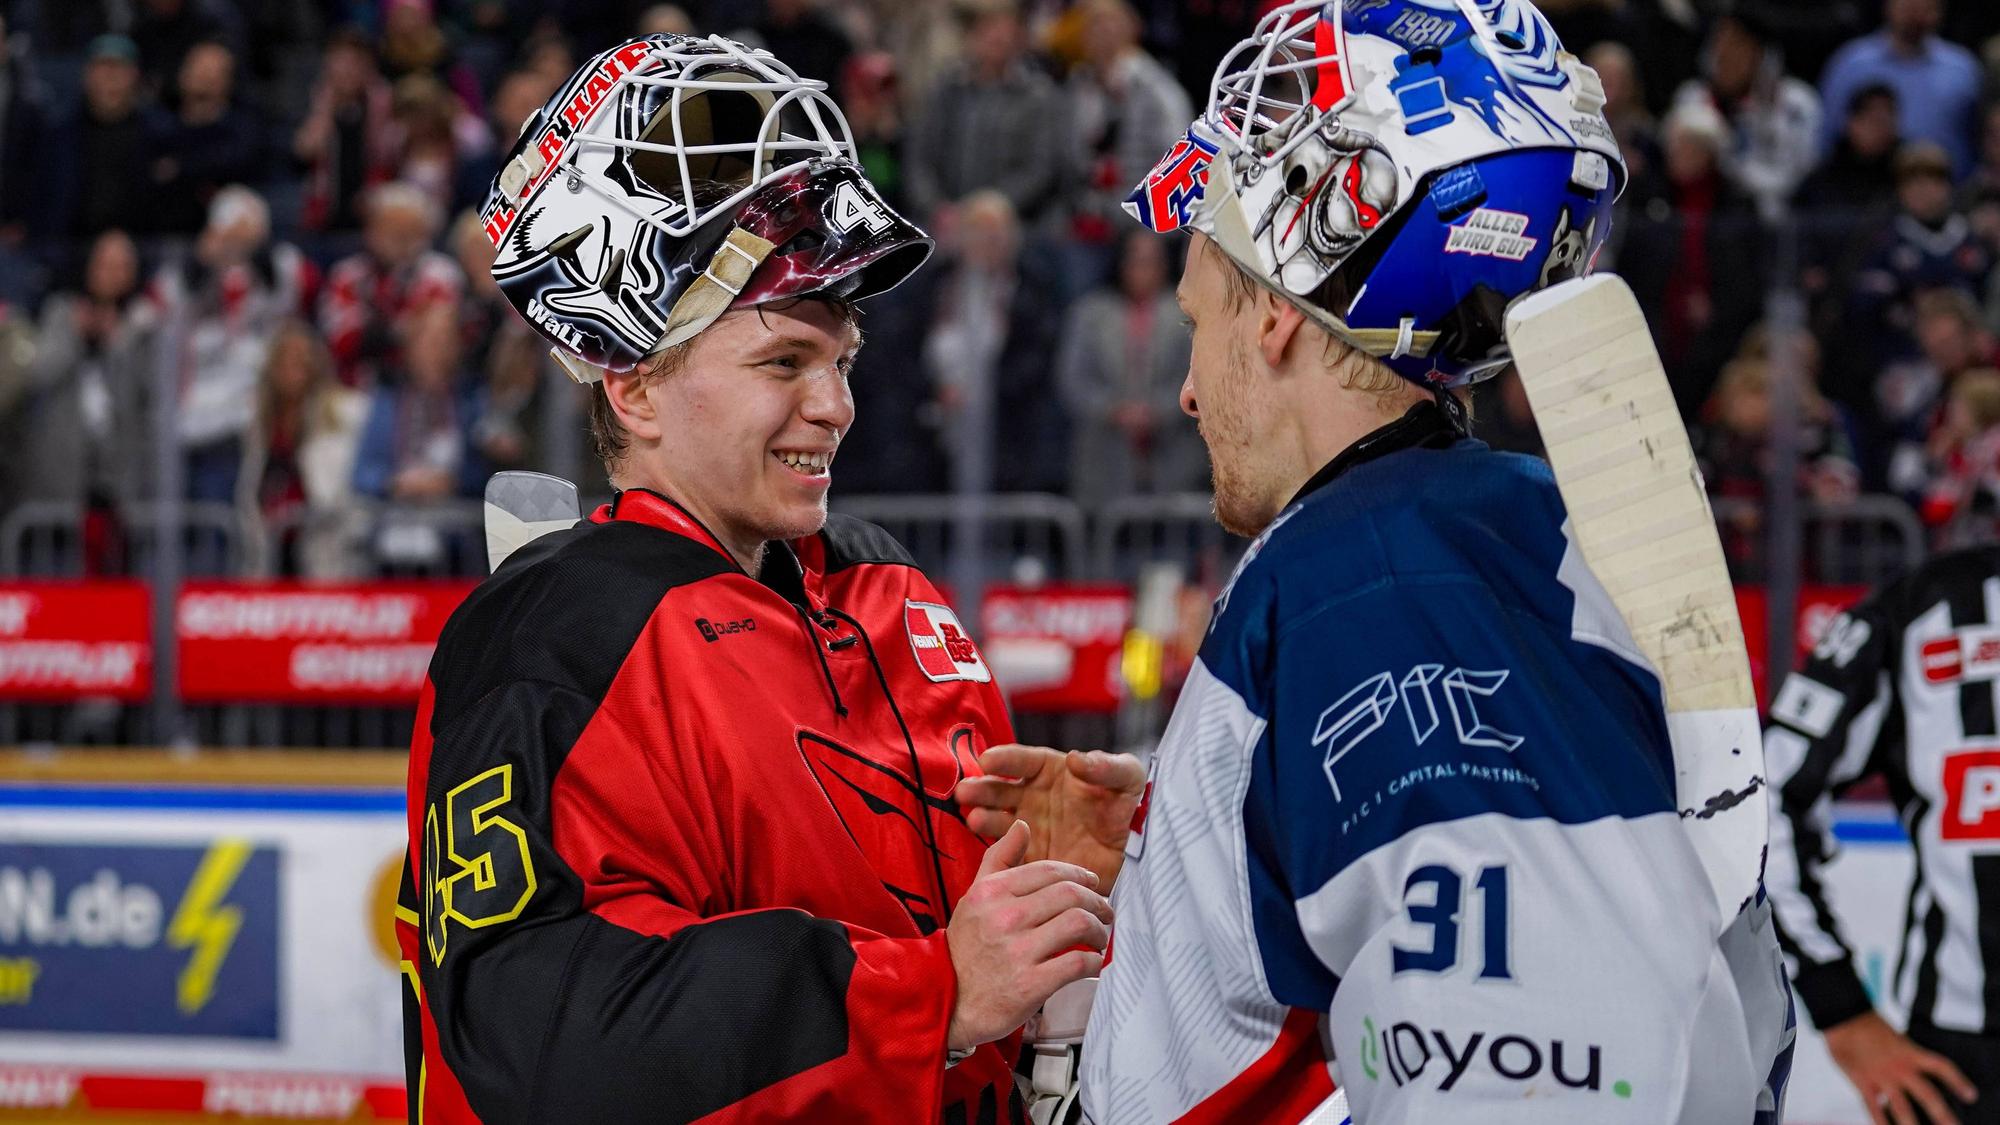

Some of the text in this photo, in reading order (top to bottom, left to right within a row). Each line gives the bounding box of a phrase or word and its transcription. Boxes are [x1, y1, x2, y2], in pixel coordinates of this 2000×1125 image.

[1386, 7, 1457, 47] 1980
[562, 40, 652, 129] HAIE
[831, 180, 895, 235] 4
[1469, 211, 1526, 235] ALLES
[1450, 229, 1532, 257] WIRD GUT
[1388, 762, 1457, 796] CAPITAL
[1390, 862, 1522, 986] 31
